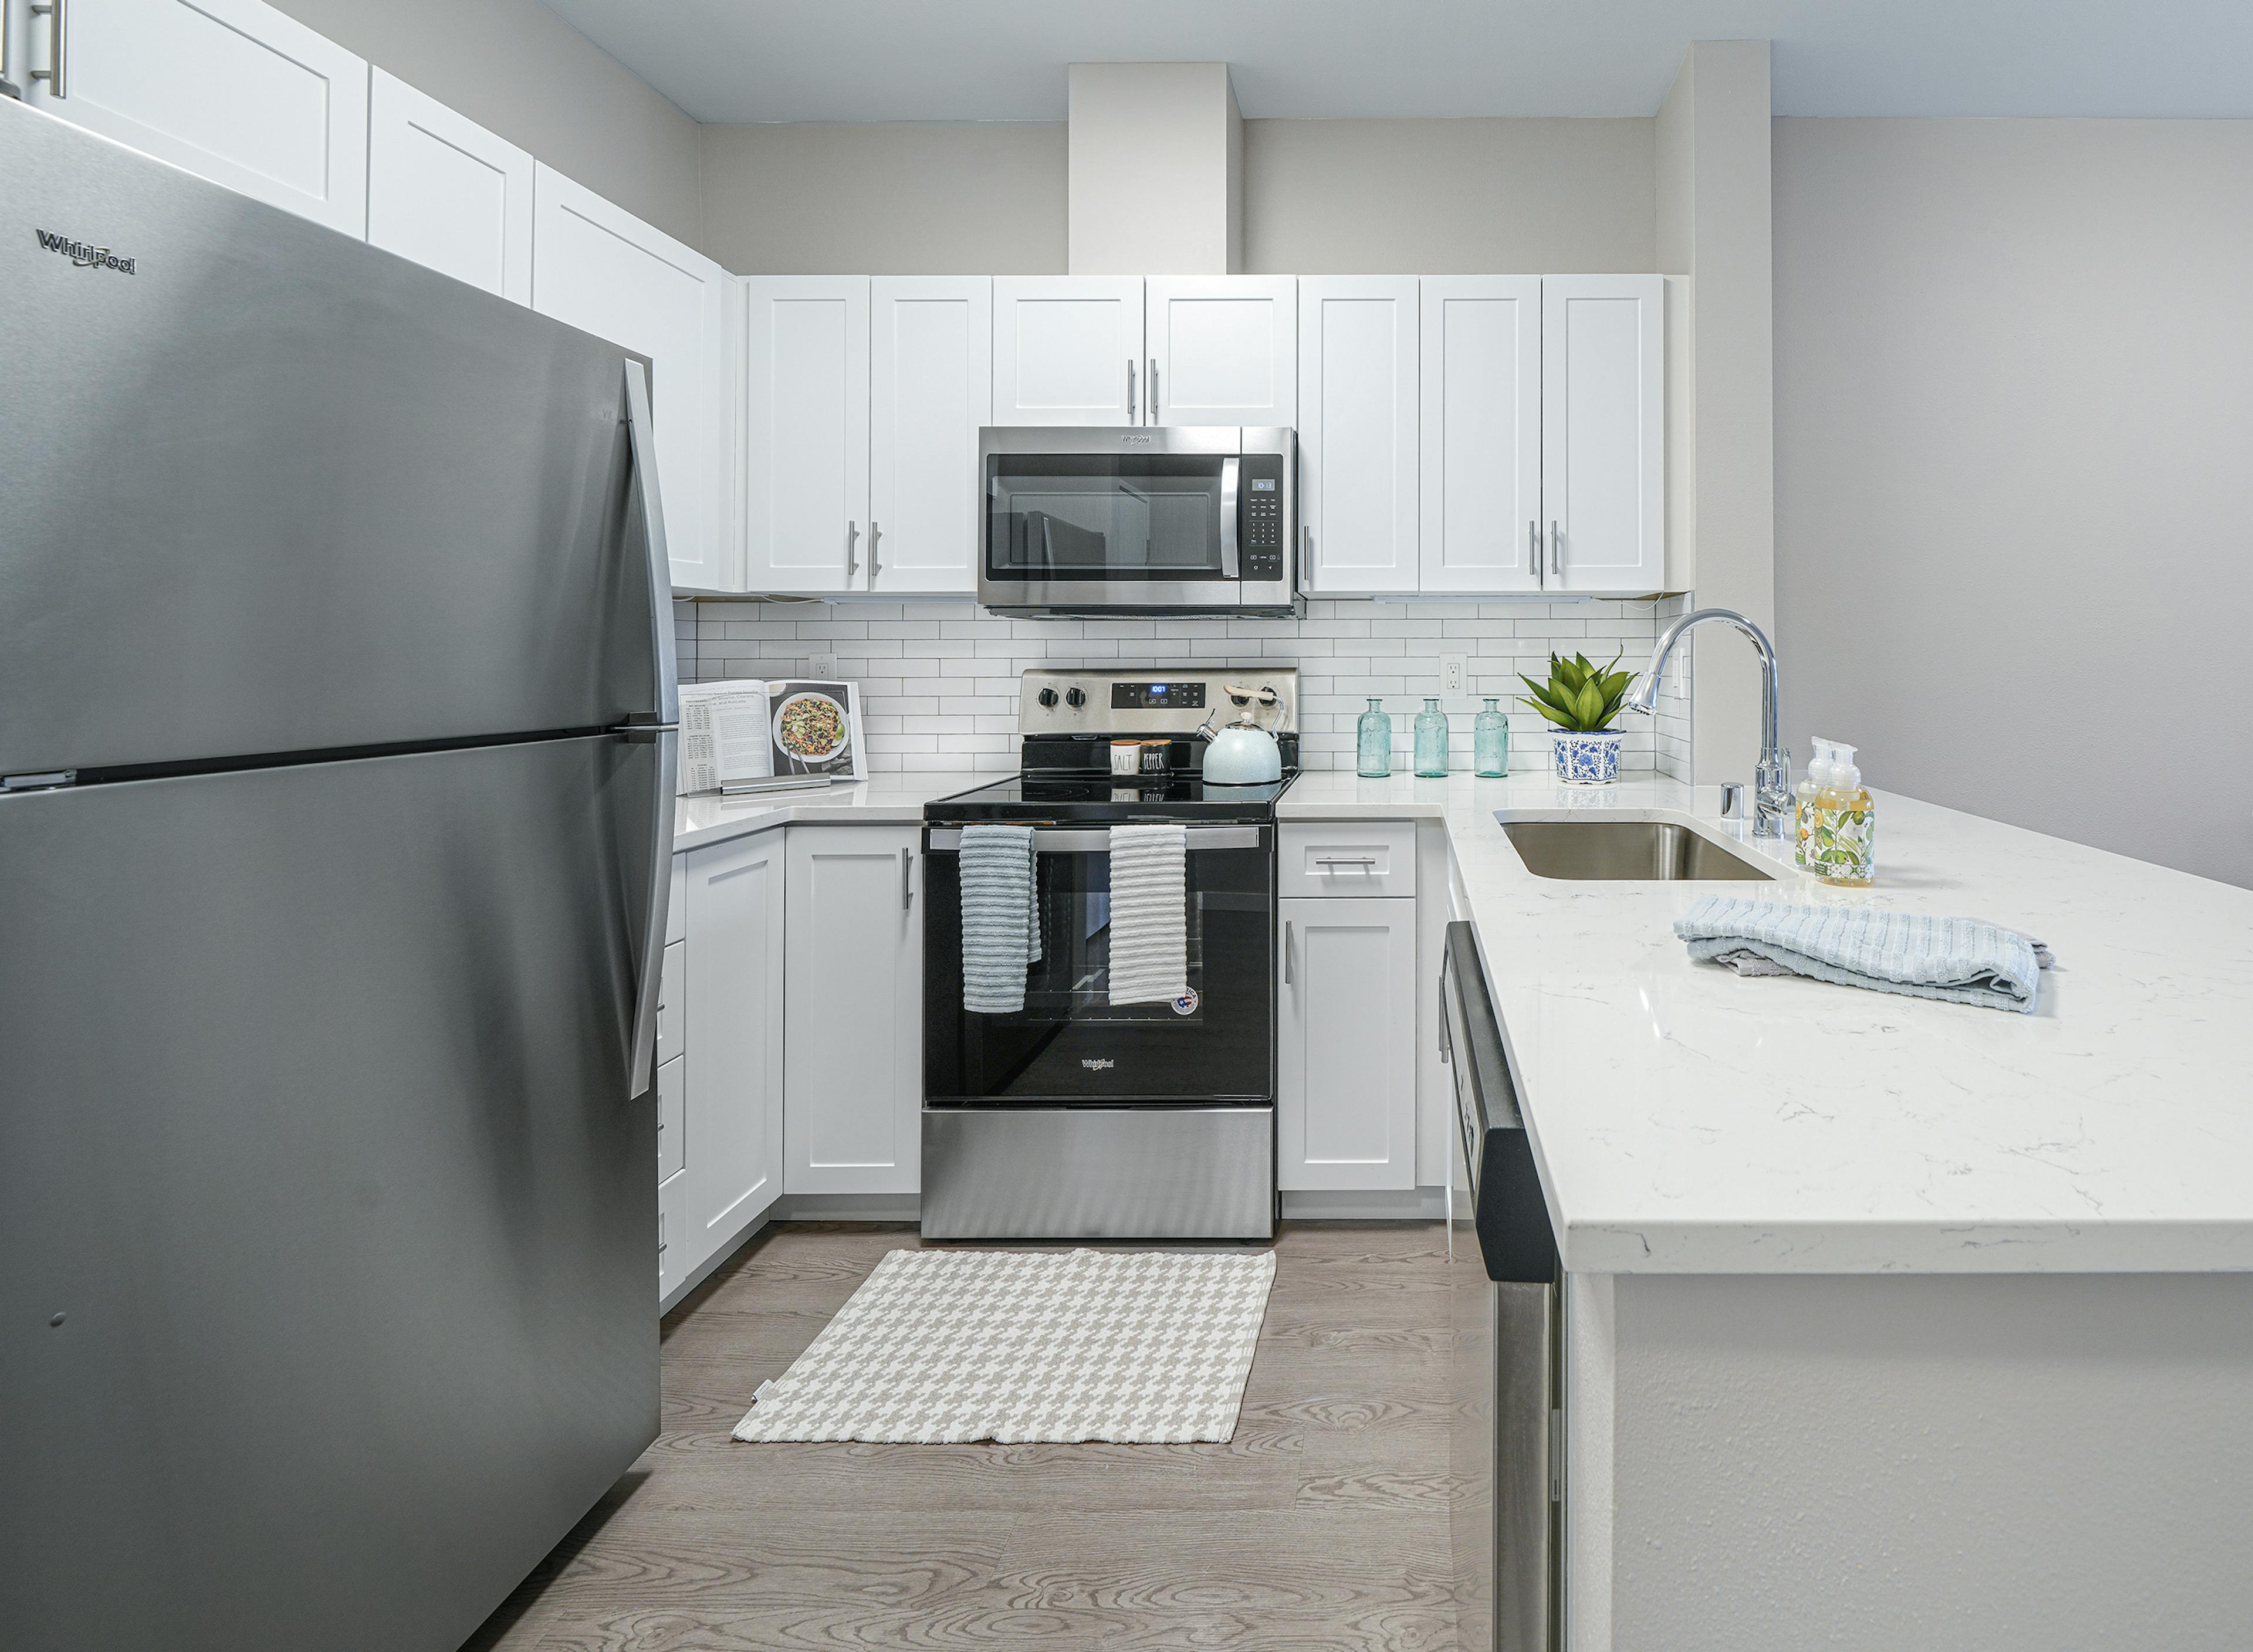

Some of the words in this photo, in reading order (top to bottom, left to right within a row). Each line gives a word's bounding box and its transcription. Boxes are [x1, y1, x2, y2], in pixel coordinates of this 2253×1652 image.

[36, 228, 136, 275] Whirlpool
[1114, 754, 1132, 771] SALT
[1143, 753, 1165, 770] PEPPER
[1082, 1059, 1115, 1071] Whirlpool
